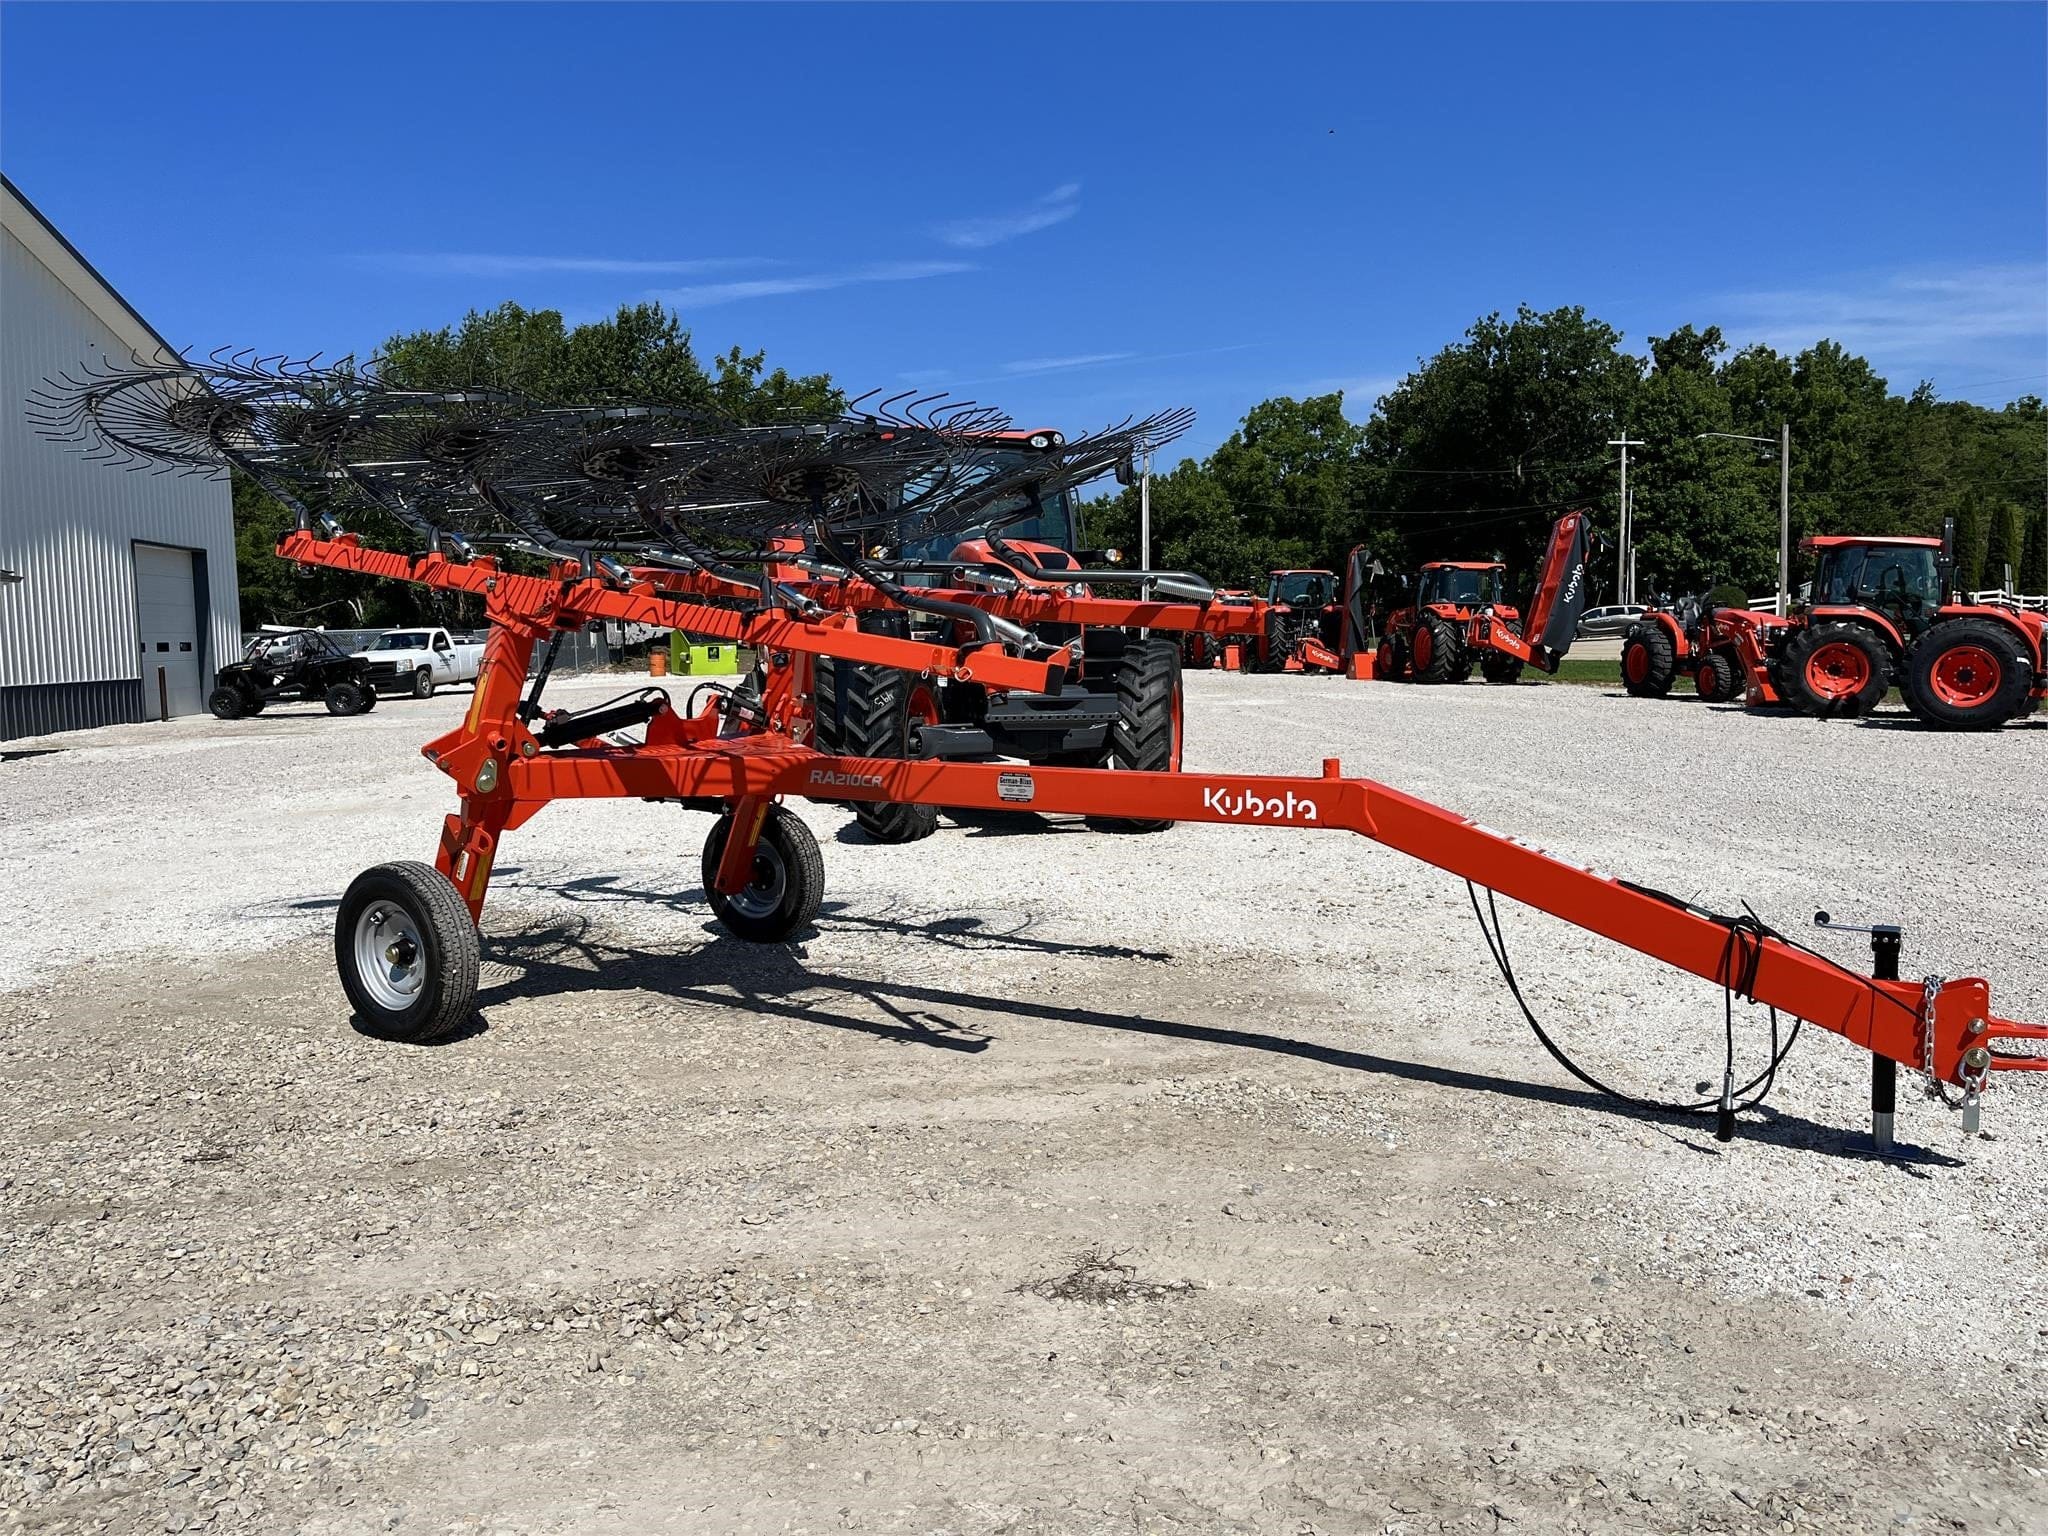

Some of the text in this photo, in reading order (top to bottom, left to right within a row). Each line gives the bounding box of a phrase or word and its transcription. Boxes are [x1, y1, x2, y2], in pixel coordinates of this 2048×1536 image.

[1563, 564, 1583, 603] Kubota
[1496, 628, 1520, 650] Kubota
[809, 769, 883, 787] RA210CR
[1203, 787, 1317, 820] Kubota
